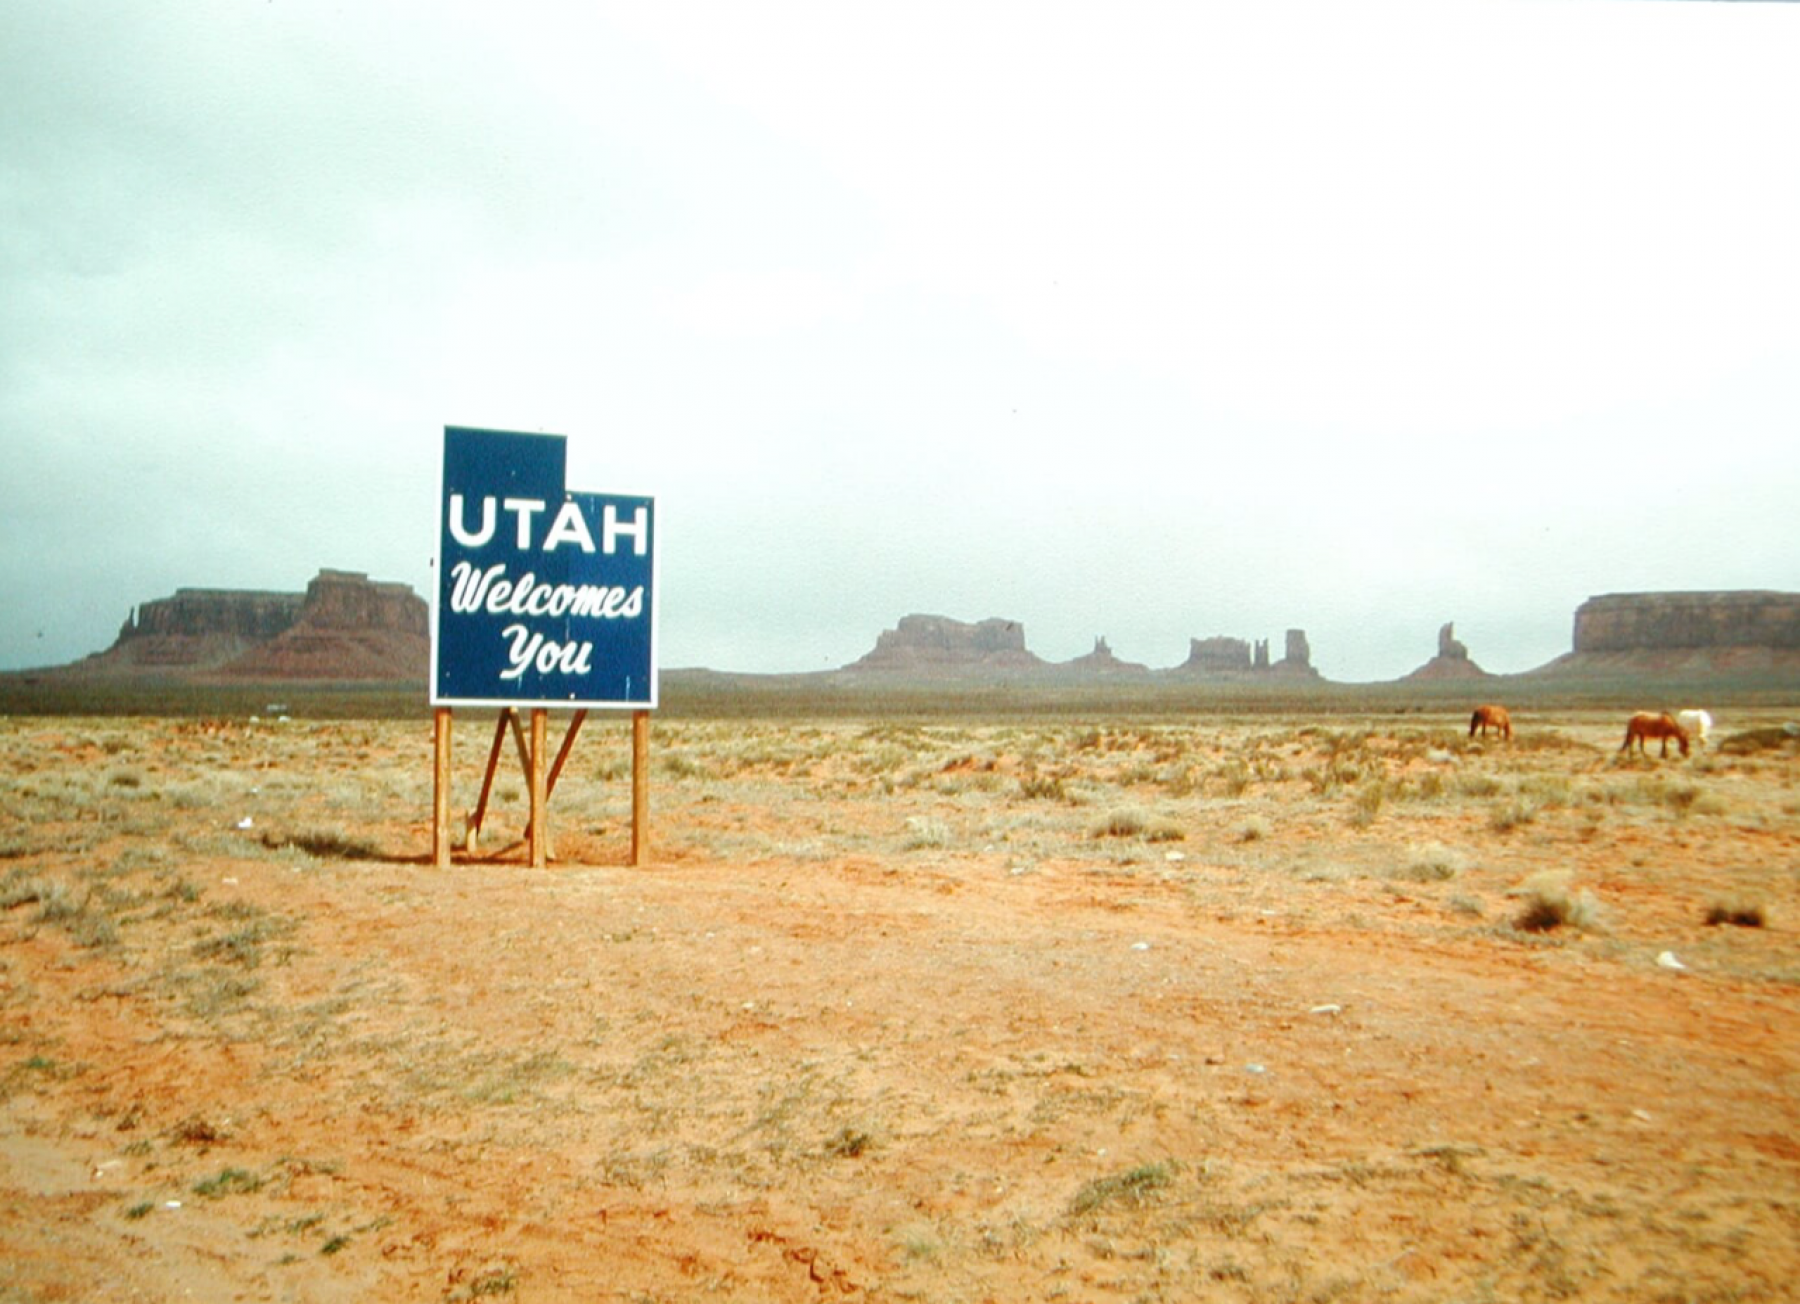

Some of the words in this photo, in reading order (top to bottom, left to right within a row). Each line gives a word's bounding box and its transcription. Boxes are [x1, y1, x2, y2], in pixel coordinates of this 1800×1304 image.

[449, 493, 648, 556] UTAH
[450, 561, 645, 619] Welcomes
[499, 623, 593, 679] You
